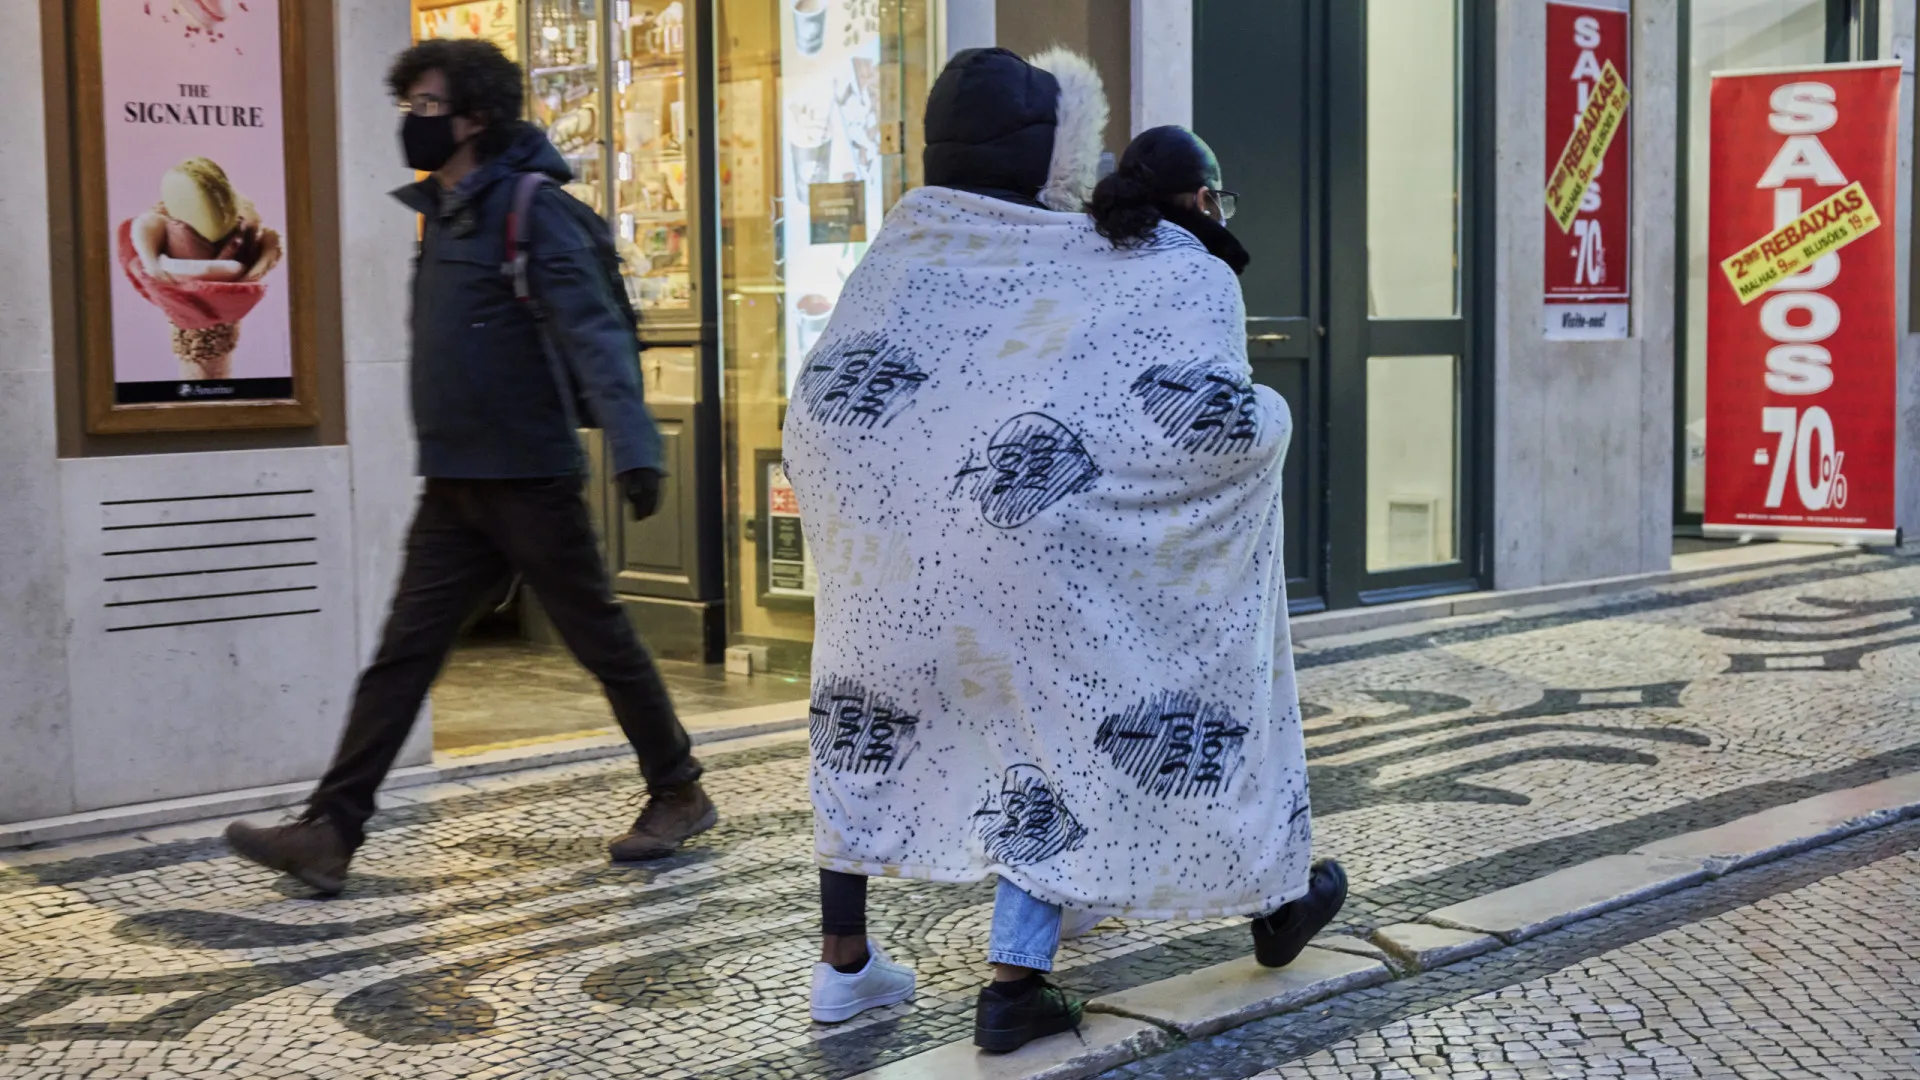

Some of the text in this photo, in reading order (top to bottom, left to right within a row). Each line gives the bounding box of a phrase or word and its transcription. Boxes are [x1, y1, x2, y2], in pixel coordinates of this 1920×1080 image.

[124, 102, 264, 128] SIGNATURE
[178, 83, 210, 98] THE
[1760, 189, 1863, 262] REBAIXAS
[1739, 268, 1778, 296] MALHAS
[1803, 226, 1848, 257] BLUSÕES
[1754, 405, 1848, 511] -70%
